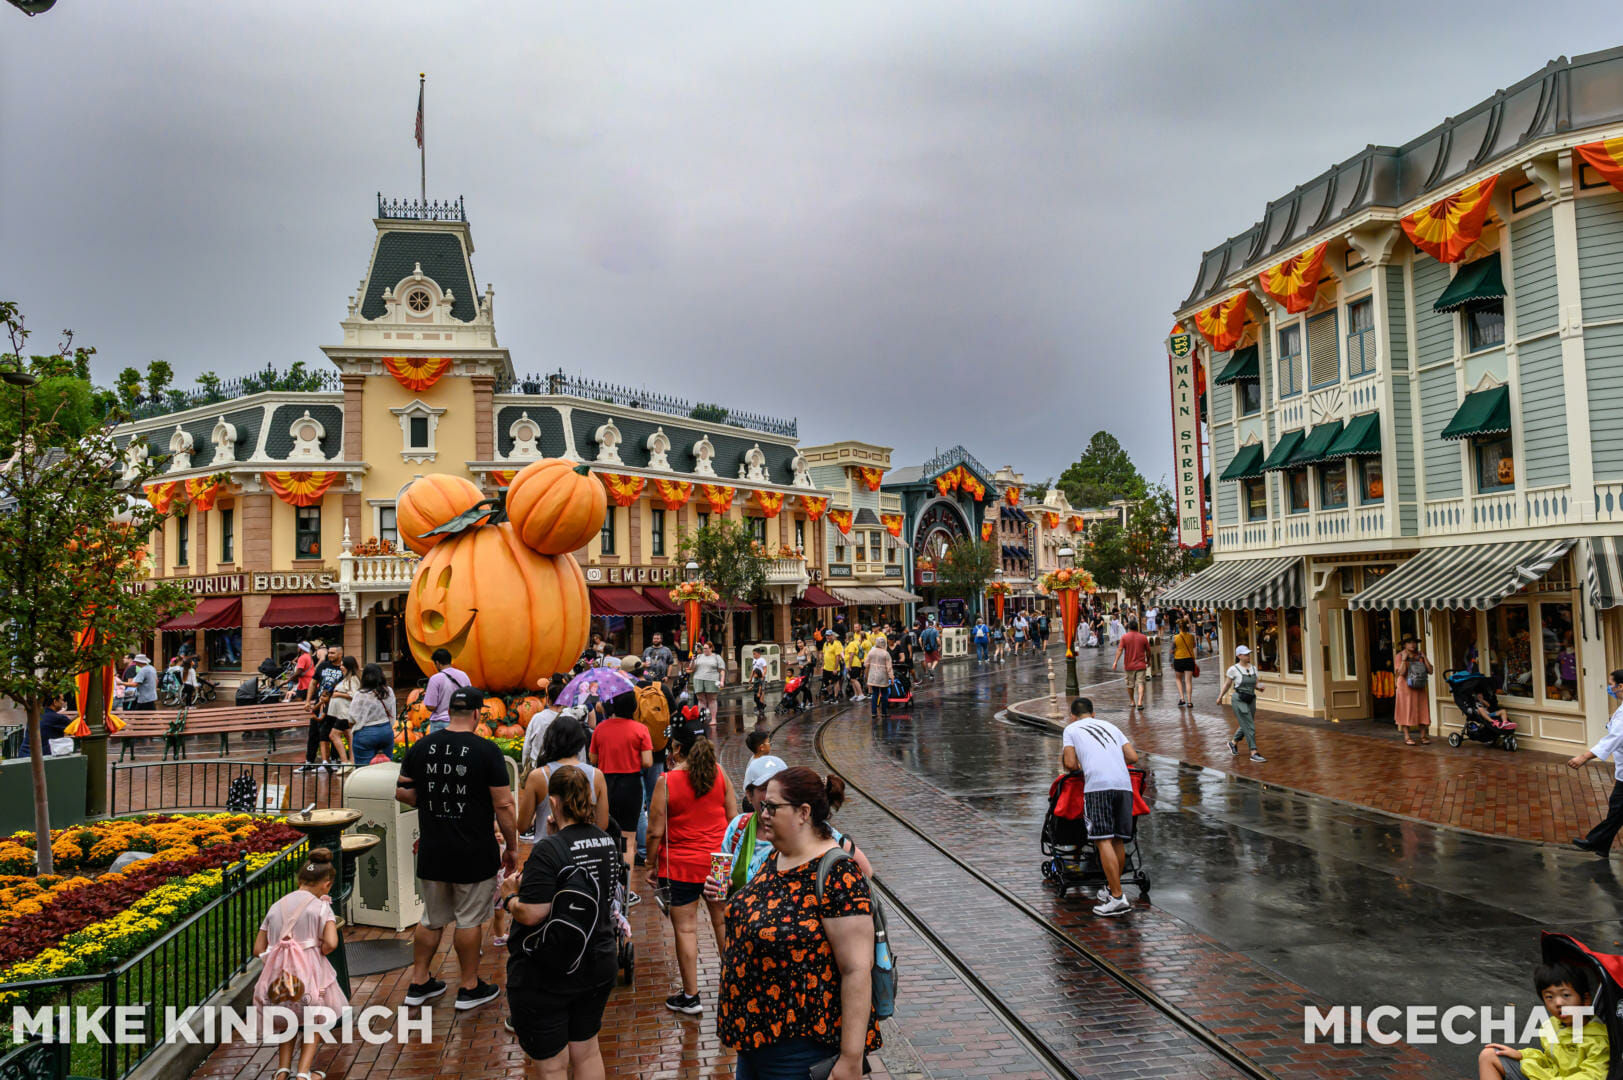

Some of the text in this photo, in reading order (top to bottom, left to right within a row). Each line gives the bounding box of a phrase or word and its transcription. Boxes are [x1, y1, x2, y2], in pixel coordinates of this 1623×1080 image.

[1176, 364, 1195, 510] MAIN STREET
[1182, 516, 1200, 531] HOTEL
[254, 573, 333, 591] BOOKS
[806, 568, 823, 583] YS
[169, 575, 240, 594] PORIUM
[570, 836, 616, 851] STAR WA
